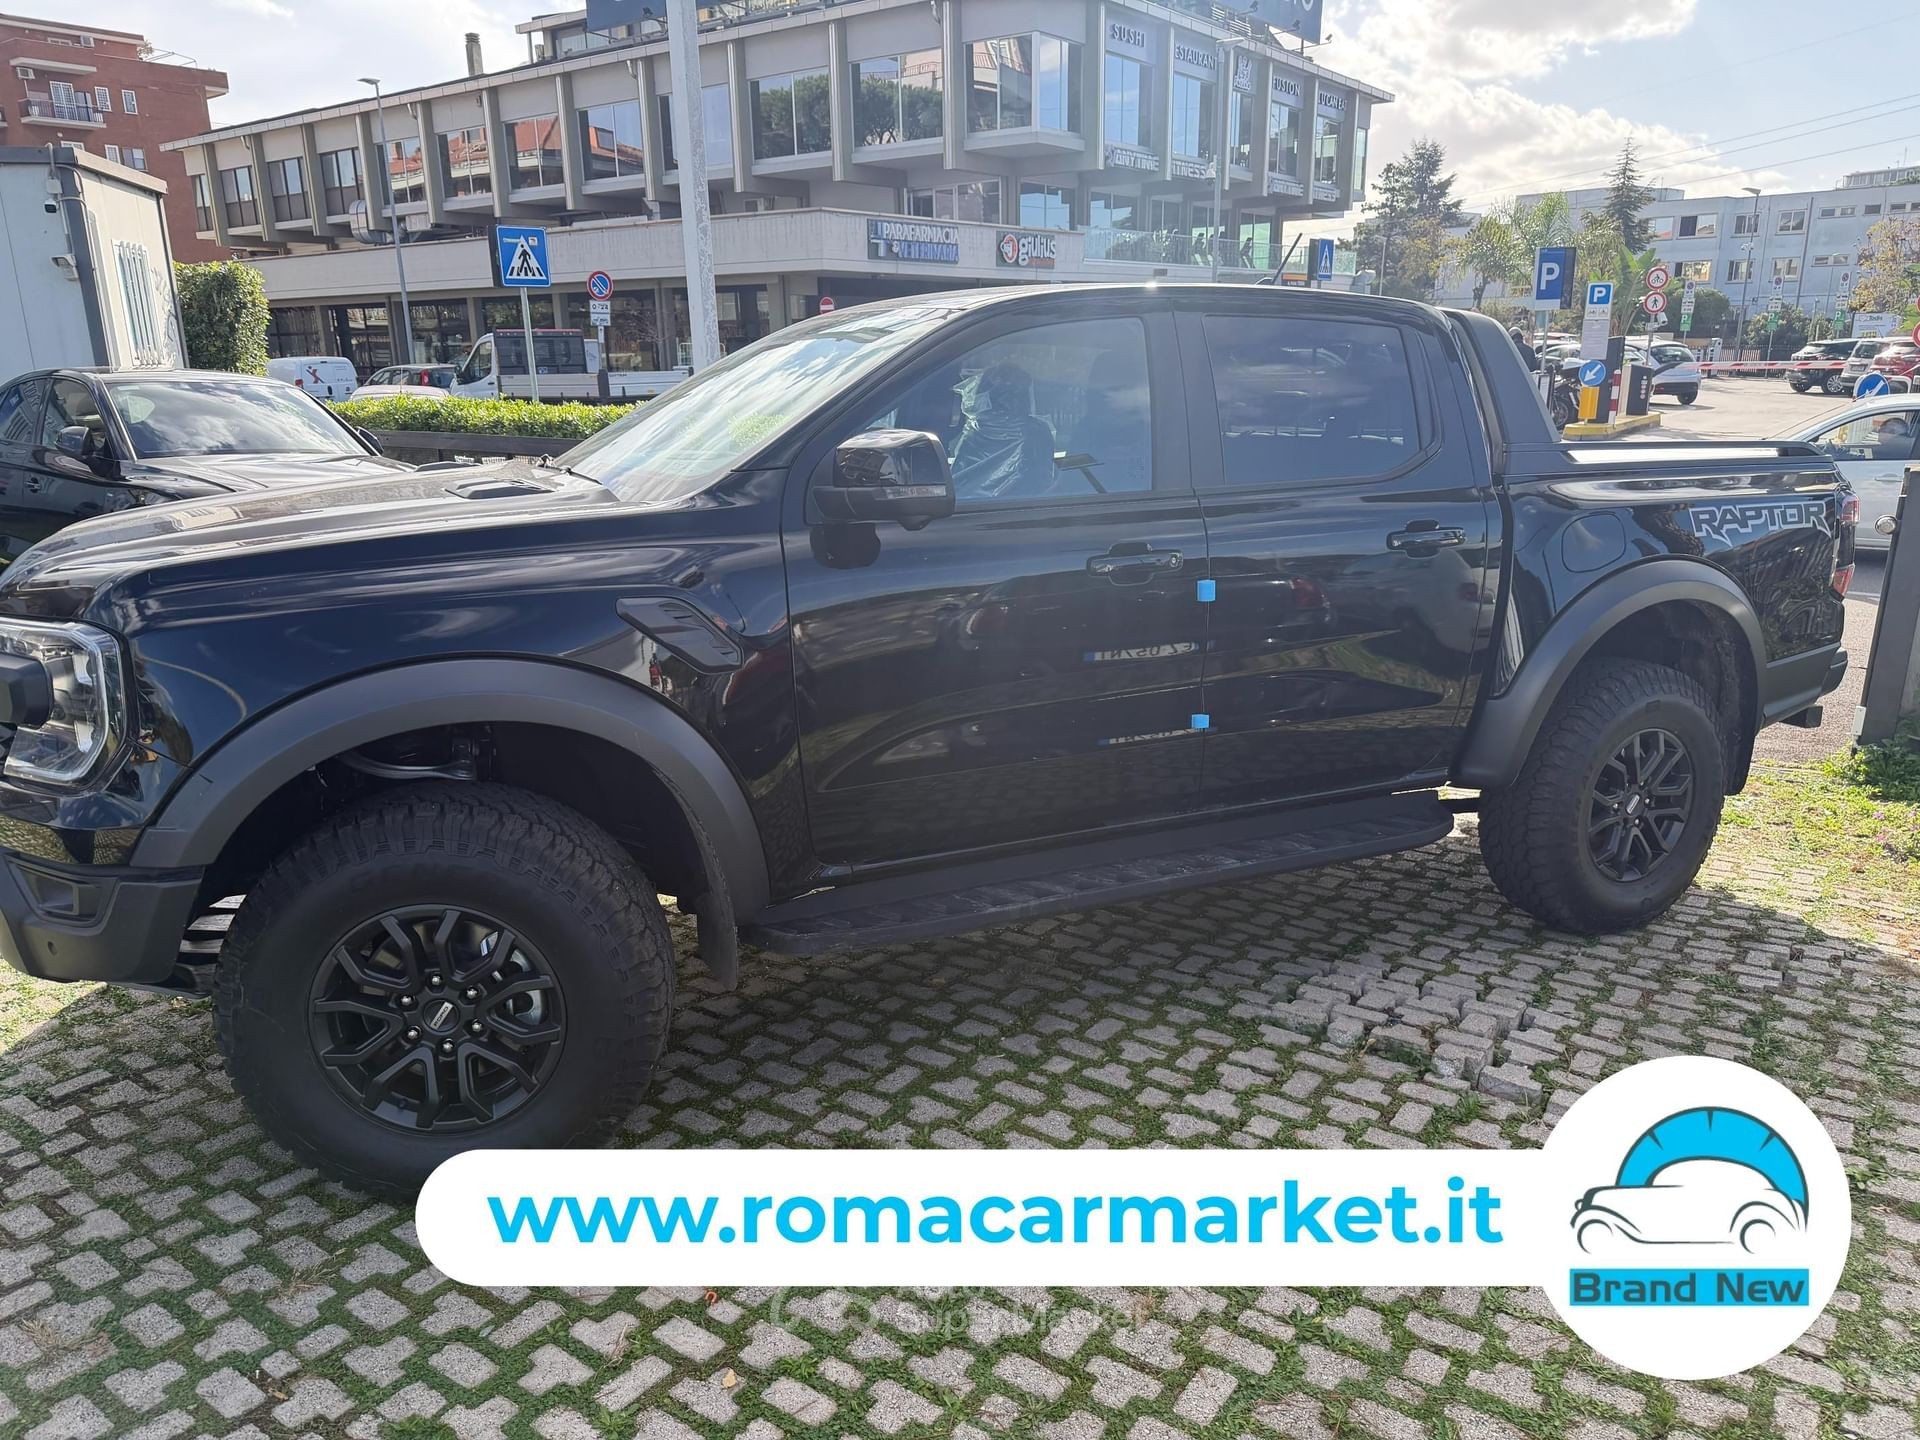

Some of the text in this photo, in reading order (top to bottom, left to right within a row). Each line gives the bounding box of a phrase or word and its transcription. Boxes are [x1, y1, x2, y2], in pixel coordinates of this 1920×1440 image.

[1112, 23, 1145, 48] SUSHI
[1175, 44, 1217, 70] ESTAURANT
[1272, 75, 1301, 97] FUSION
[883, 222, 959, 244] PARAFARMACIA
[1019, 235, 1056, 266] giulius
[1540, 262, 1560, 290] P
[1593, 287, 1607, 302] P
[1689, 501, 1832, 548] RAPTOR
